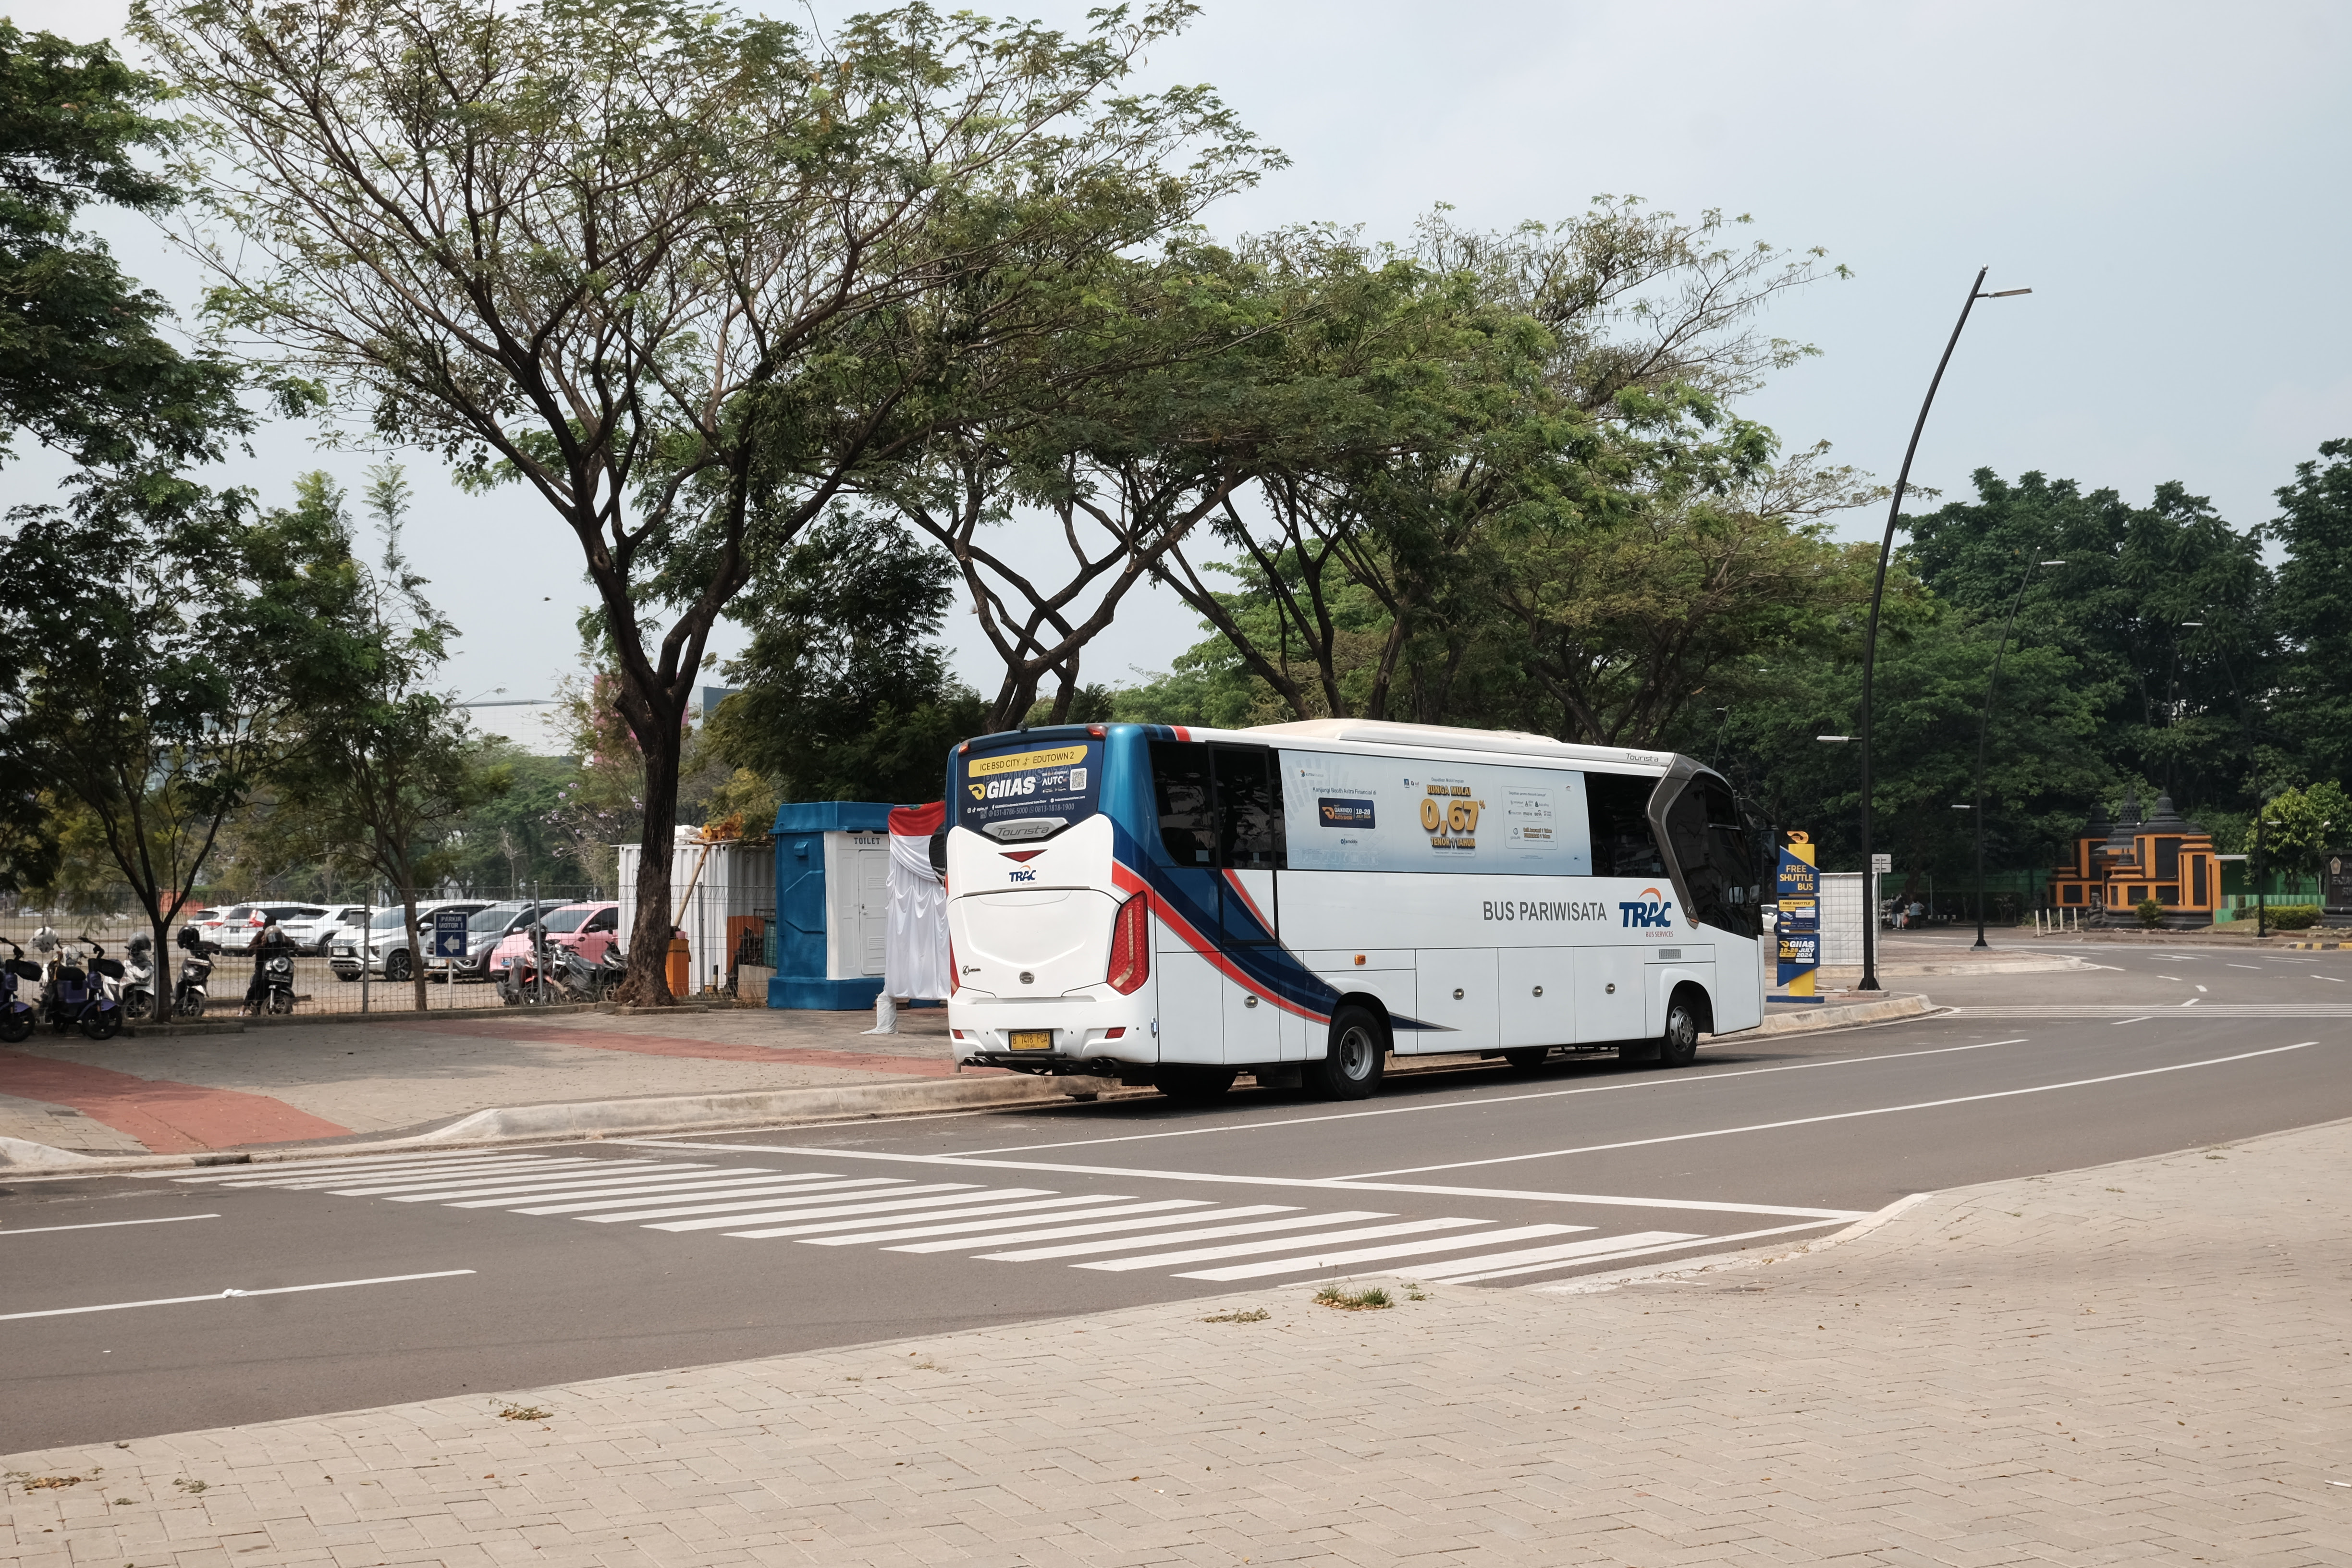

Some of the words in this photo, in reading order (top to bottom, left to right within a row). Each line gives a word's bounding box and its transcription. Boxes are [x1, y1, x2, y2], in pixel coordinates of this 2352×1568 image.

[980, 763, 991, 771] ICE
[992, 761, 1004, 769] BSD
[1005, 759, 1020, 767] CITY
[1033, 752, 1068, 764] EDUTOWN
[1626, 753, 1659, 762] Tourista
[987, 776, 1036, 799] GIIAS
[1427, 784, 1450, 796] BUNGA
[1450, 786, 1471, 796] MULAI
[993, 808, 1028, 816] 031-8786-5000
[1035, 803, 1075, 812] 0813-1818-1900
[997, 825, 1050, 836] Tourista
[1431, 836, 1451, 848] TENOR
[1450, 837, 1455, 848] 1
[1455, 838, 1475, 848] TAHUN
[1009, 870, 1036, 882] TRAC
[1483, 901, 1515, 921] BUS
[1519, 901, 1607, 921] PARIWISATA
[1619, 901, 1672, 928] TRAC
[1013, 1035, 1017, 1044] B
